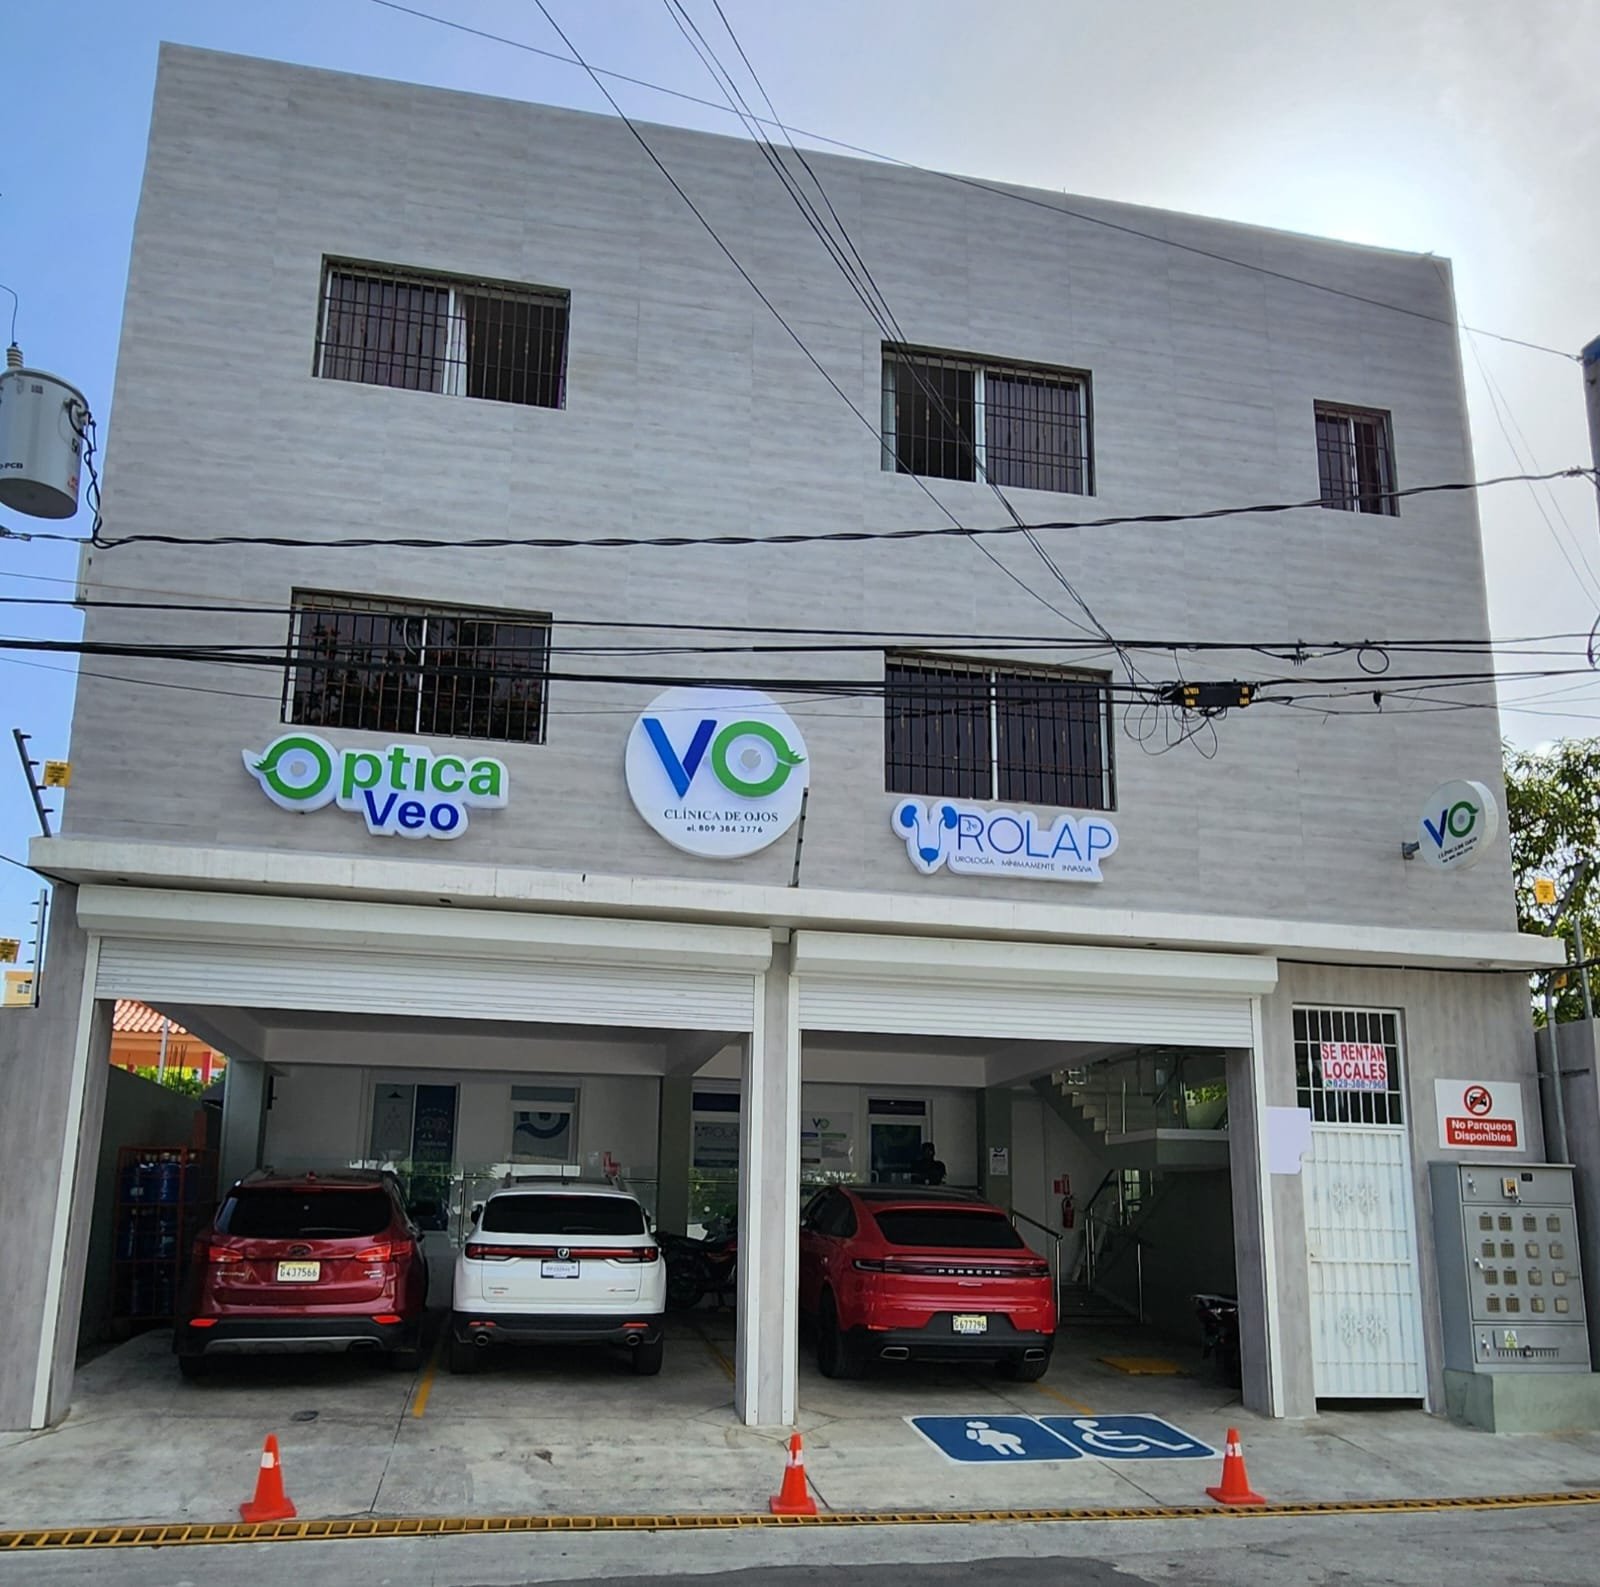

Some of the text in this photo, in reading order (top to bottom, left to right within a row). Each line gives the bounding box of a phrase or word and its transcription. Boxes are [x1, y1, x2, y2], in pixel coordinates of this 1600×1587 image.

[253, 734, 502, 800] Optica
[642, 717, 806, 798] VO
[364, 790, 460, 833] Veo
[664, 807, 779, 823] CLÍNICA DE OJOS
[698, 824, 716, 832] 809
[719, 825, 737, 833] 384
[740, 825, 764, 833] 2776
[1423, 801, 1479, 849] VO
[1321, 1043, 1385, 1062] SE RENTAN
[1324, 1061, 1386, 1080] LOCALES
[1451, 1120, 1513, 1132] No Parqueos
[1454, 1130, 1512, 1143] Disponibles
